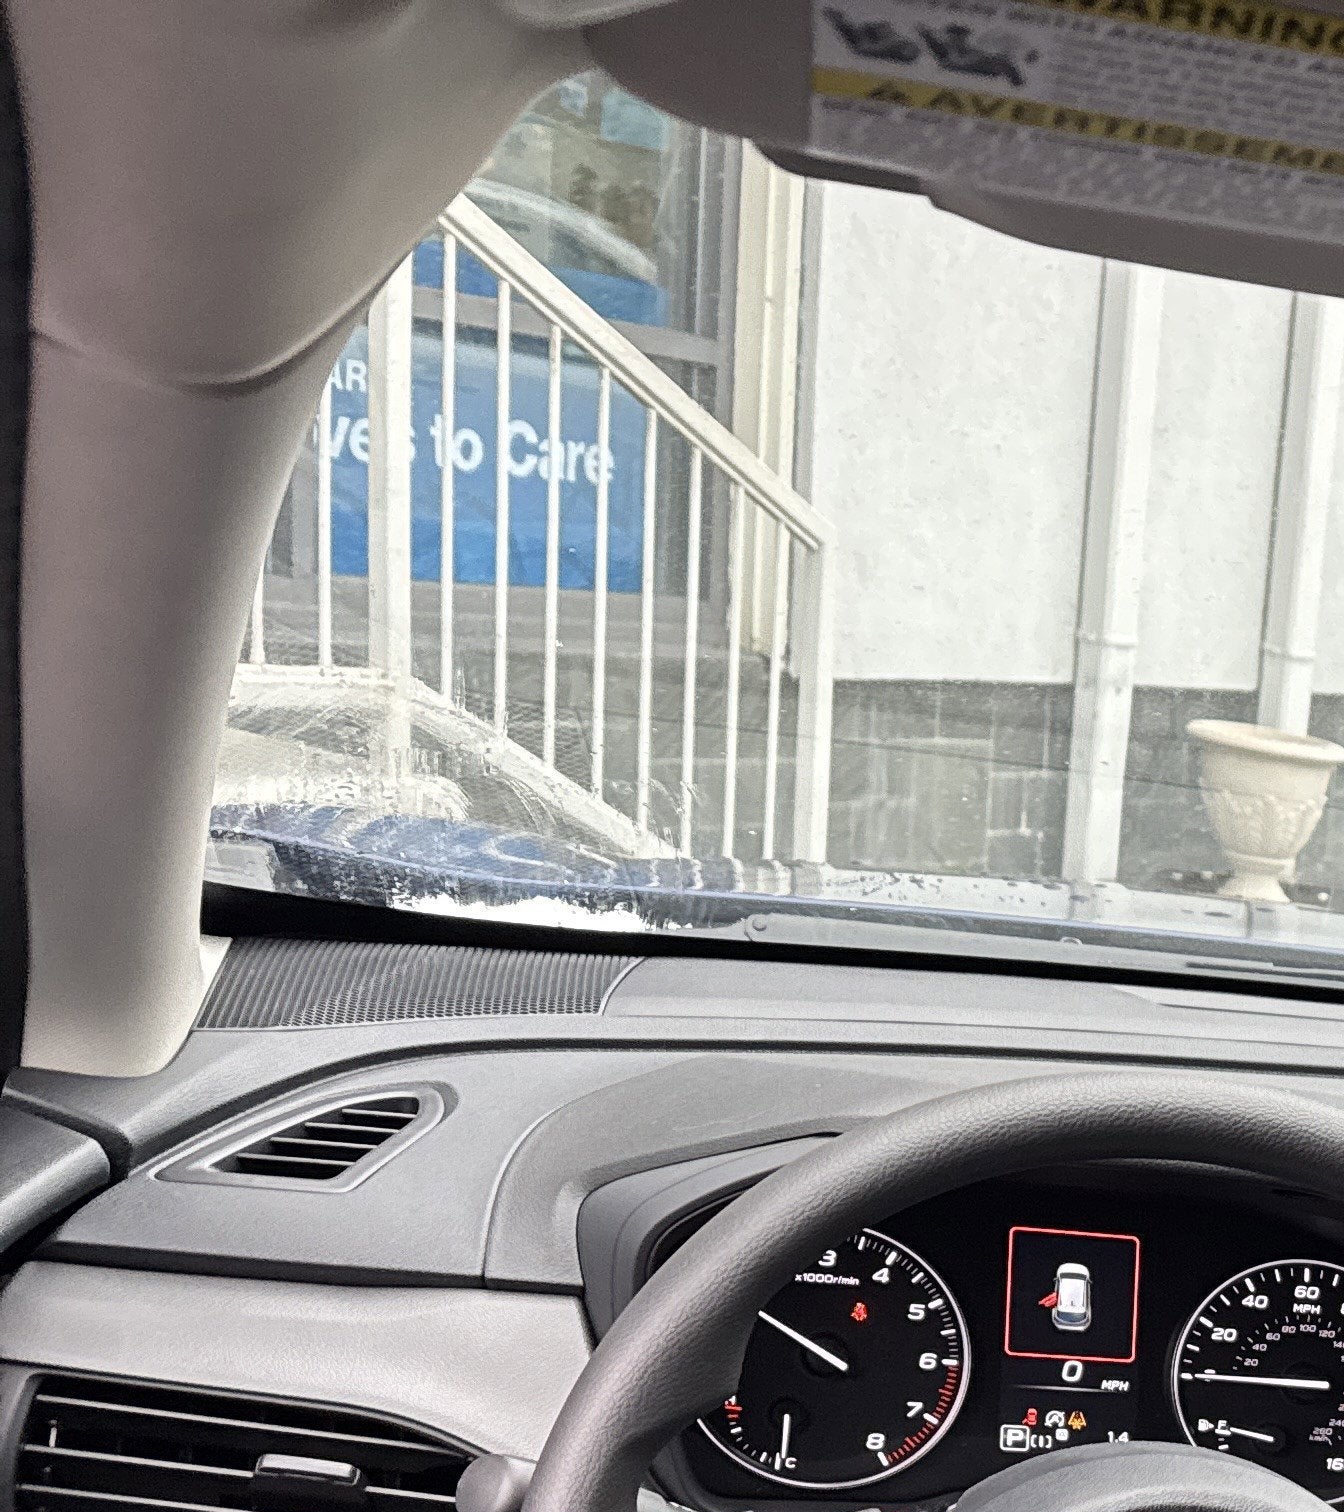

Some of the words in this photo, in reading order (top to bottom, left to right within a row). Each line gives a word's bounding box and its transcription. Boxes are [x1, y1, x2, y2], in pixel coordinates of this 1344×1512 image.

[430, 413, 484, 472] to
[507, 418, 616, 486] Care
[818, 1250, 837, 1267] 3
[872, 1268, 890, 1283] 4
[1294, 1286, 1320, 1299] 60
[1241, 1294, 1269, 1309] 40
[1293, 1303, 1321, 1315] MPH
[907, 1303, 926, 1320] 5
[1211, 1328, 1238, 1342] 20
[918, 1352, 938, 1370] 6
[1062, 1360, 1083, 1382] 0
[1101, 1379, 1130, 1392] MPH
[906, 1401, 924, 1417] 7
[866, 1433, 886, 1450] 8
